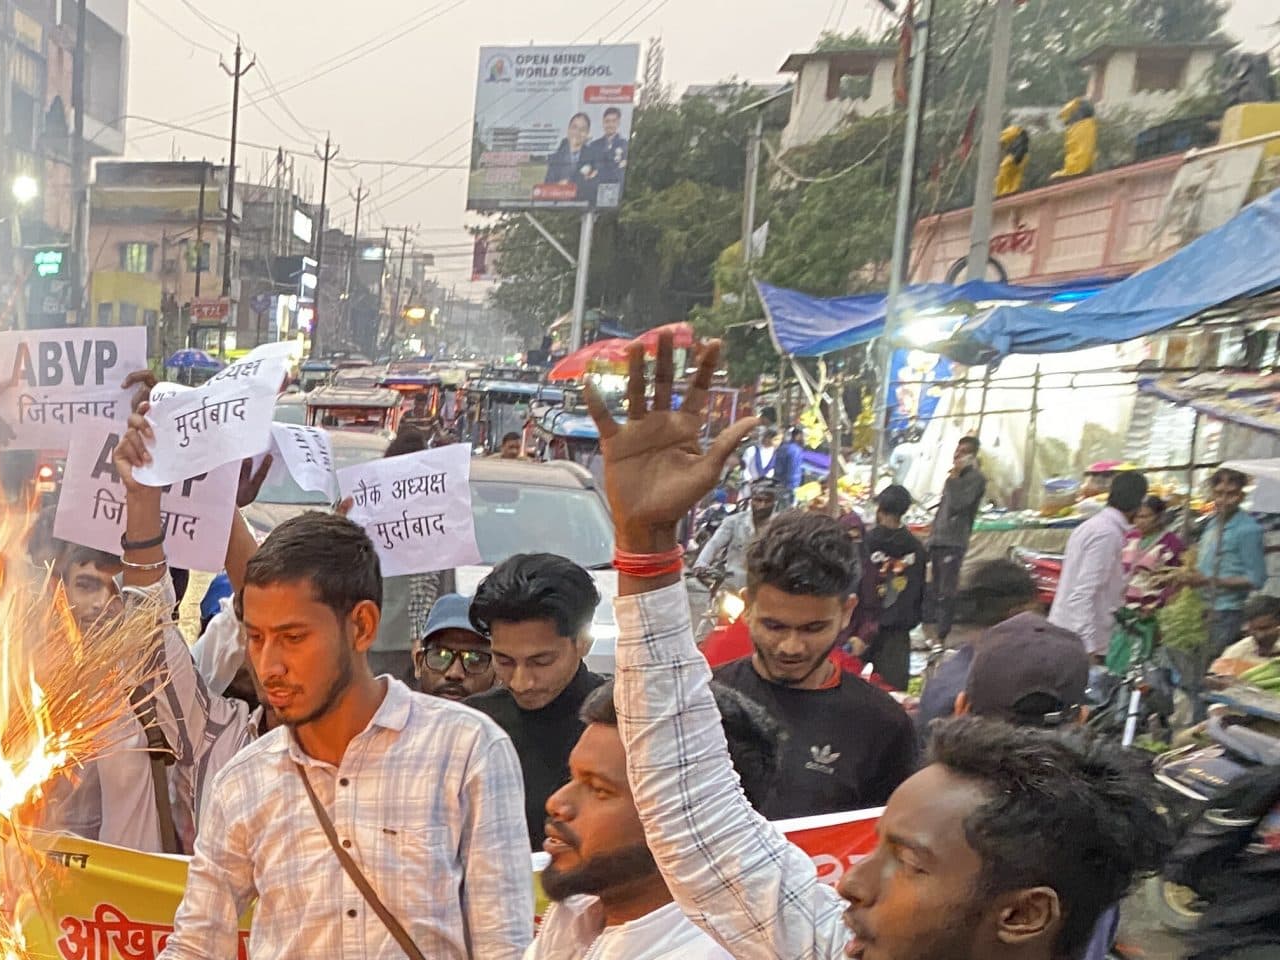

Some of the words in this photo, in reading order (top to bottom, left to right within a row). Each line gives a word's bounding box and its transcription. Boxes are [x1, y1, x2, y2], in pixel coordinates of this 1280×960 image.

[515, 55, 549, 65] OPEN
[553, 53, 586, 64] MIND
[515, 67, 558, 78] WORLD
[562, 65, 612, 77] SCHOOL
[11, 340, 118, 387] ABVP
[174, 396, 249, 447] मुर्दाबाद
[352, 479, 381, 507] जैक
[391, 472, 447, 500] अध्यक्ष
[370, 509, 445, 550] मुर्दाबाद
